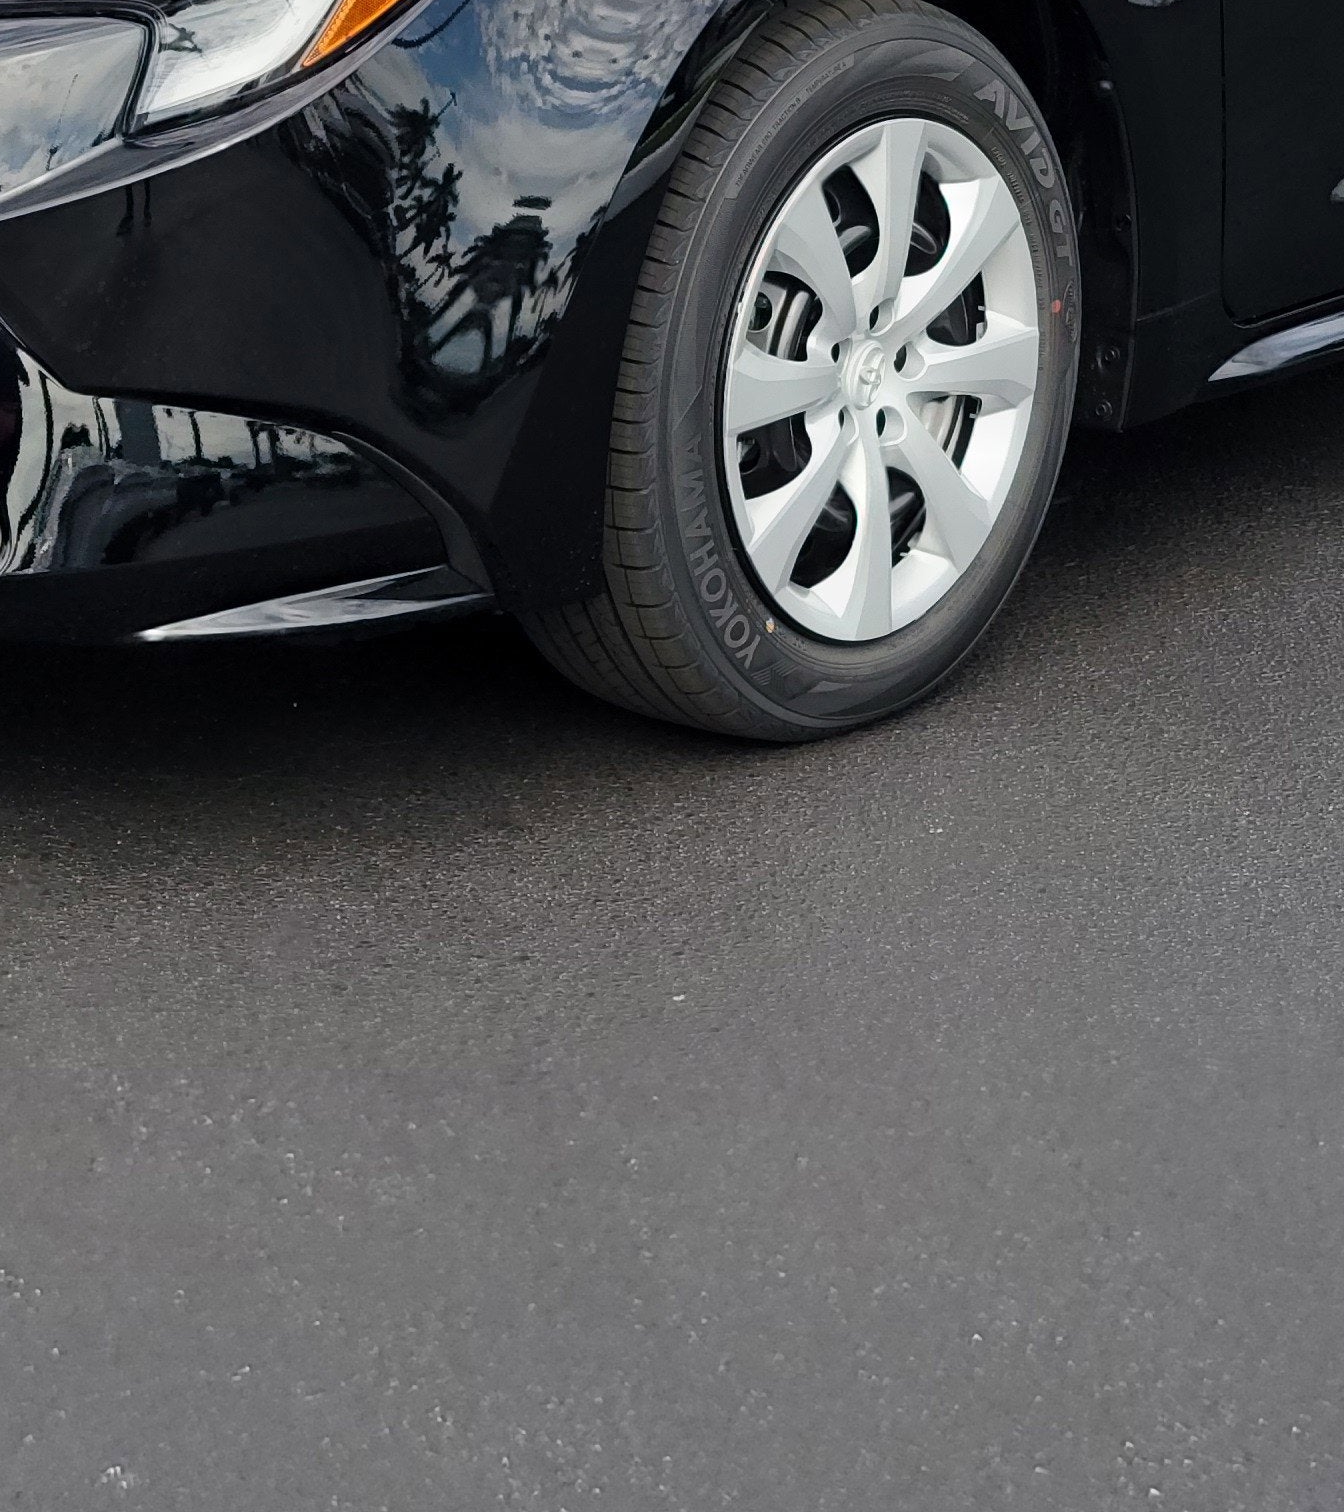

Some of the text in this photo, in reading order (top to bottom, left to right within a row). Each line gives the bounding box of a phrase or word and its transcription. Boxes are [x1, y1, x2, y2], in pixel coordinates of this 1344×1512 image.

[973, 78, 1054, 189] AVID
[1049, 199, 1074, 267] GT
[679, 433, 760, 670] YOKOHAMA
